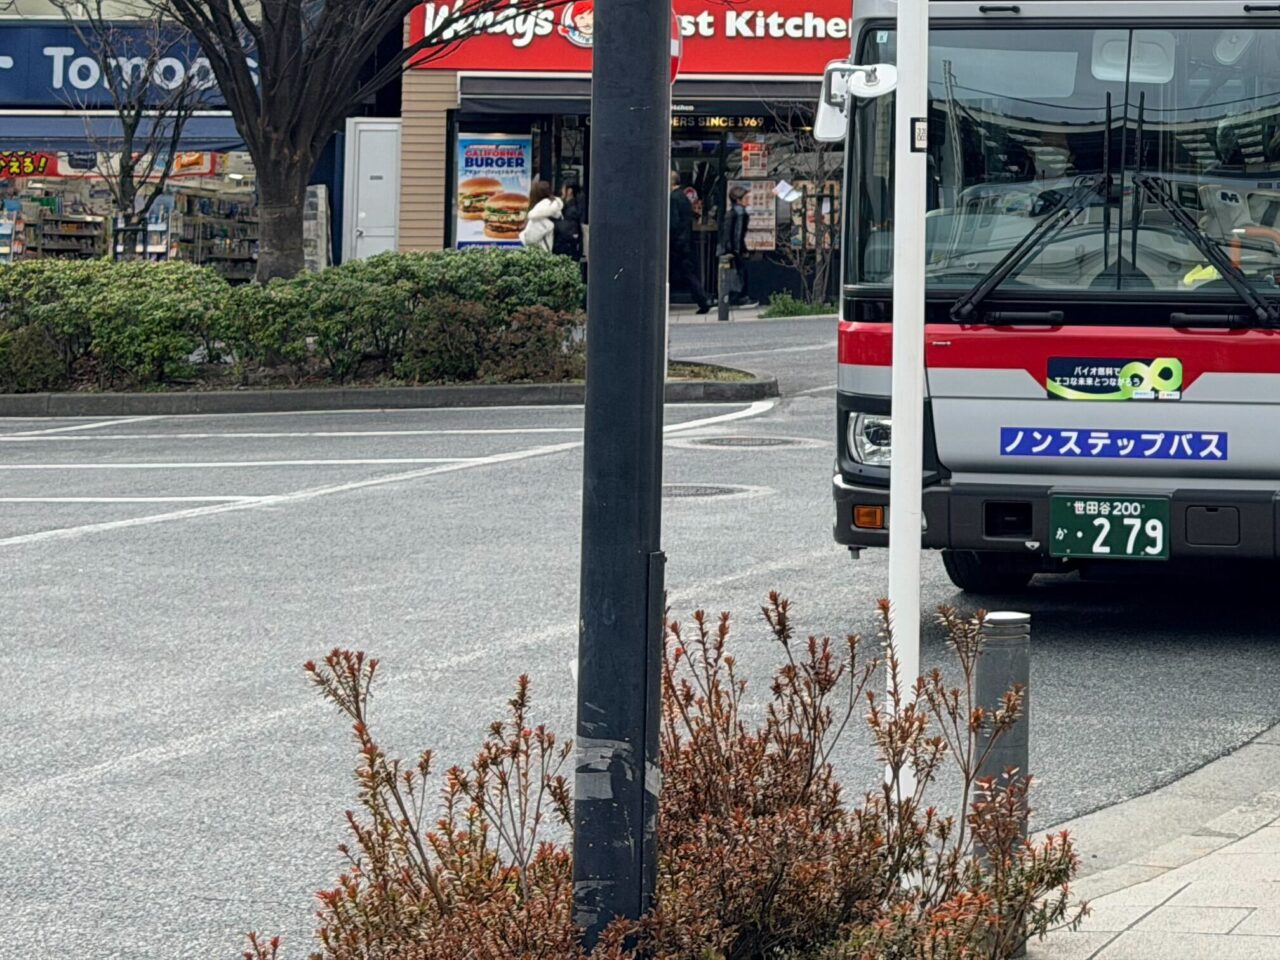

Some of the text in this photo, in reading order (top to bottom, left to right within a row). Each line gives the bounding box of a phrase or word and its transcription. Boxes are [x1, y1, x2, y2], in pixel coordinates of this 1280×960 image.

[725, 10, 852, 38] Kitche
[698, 117, 735, 127] SINCE
[738, 117, 764, 127] 1969
[0, 155, 48, 174] える!
[464, 157, 525, 168] BURGER
[1073, 366, 1122, 376] バイオ燃料で
[1054, 377, 1141, 387] エコな未来とつながろう
[1004, 429, 1224, 459] ノンステップバス
